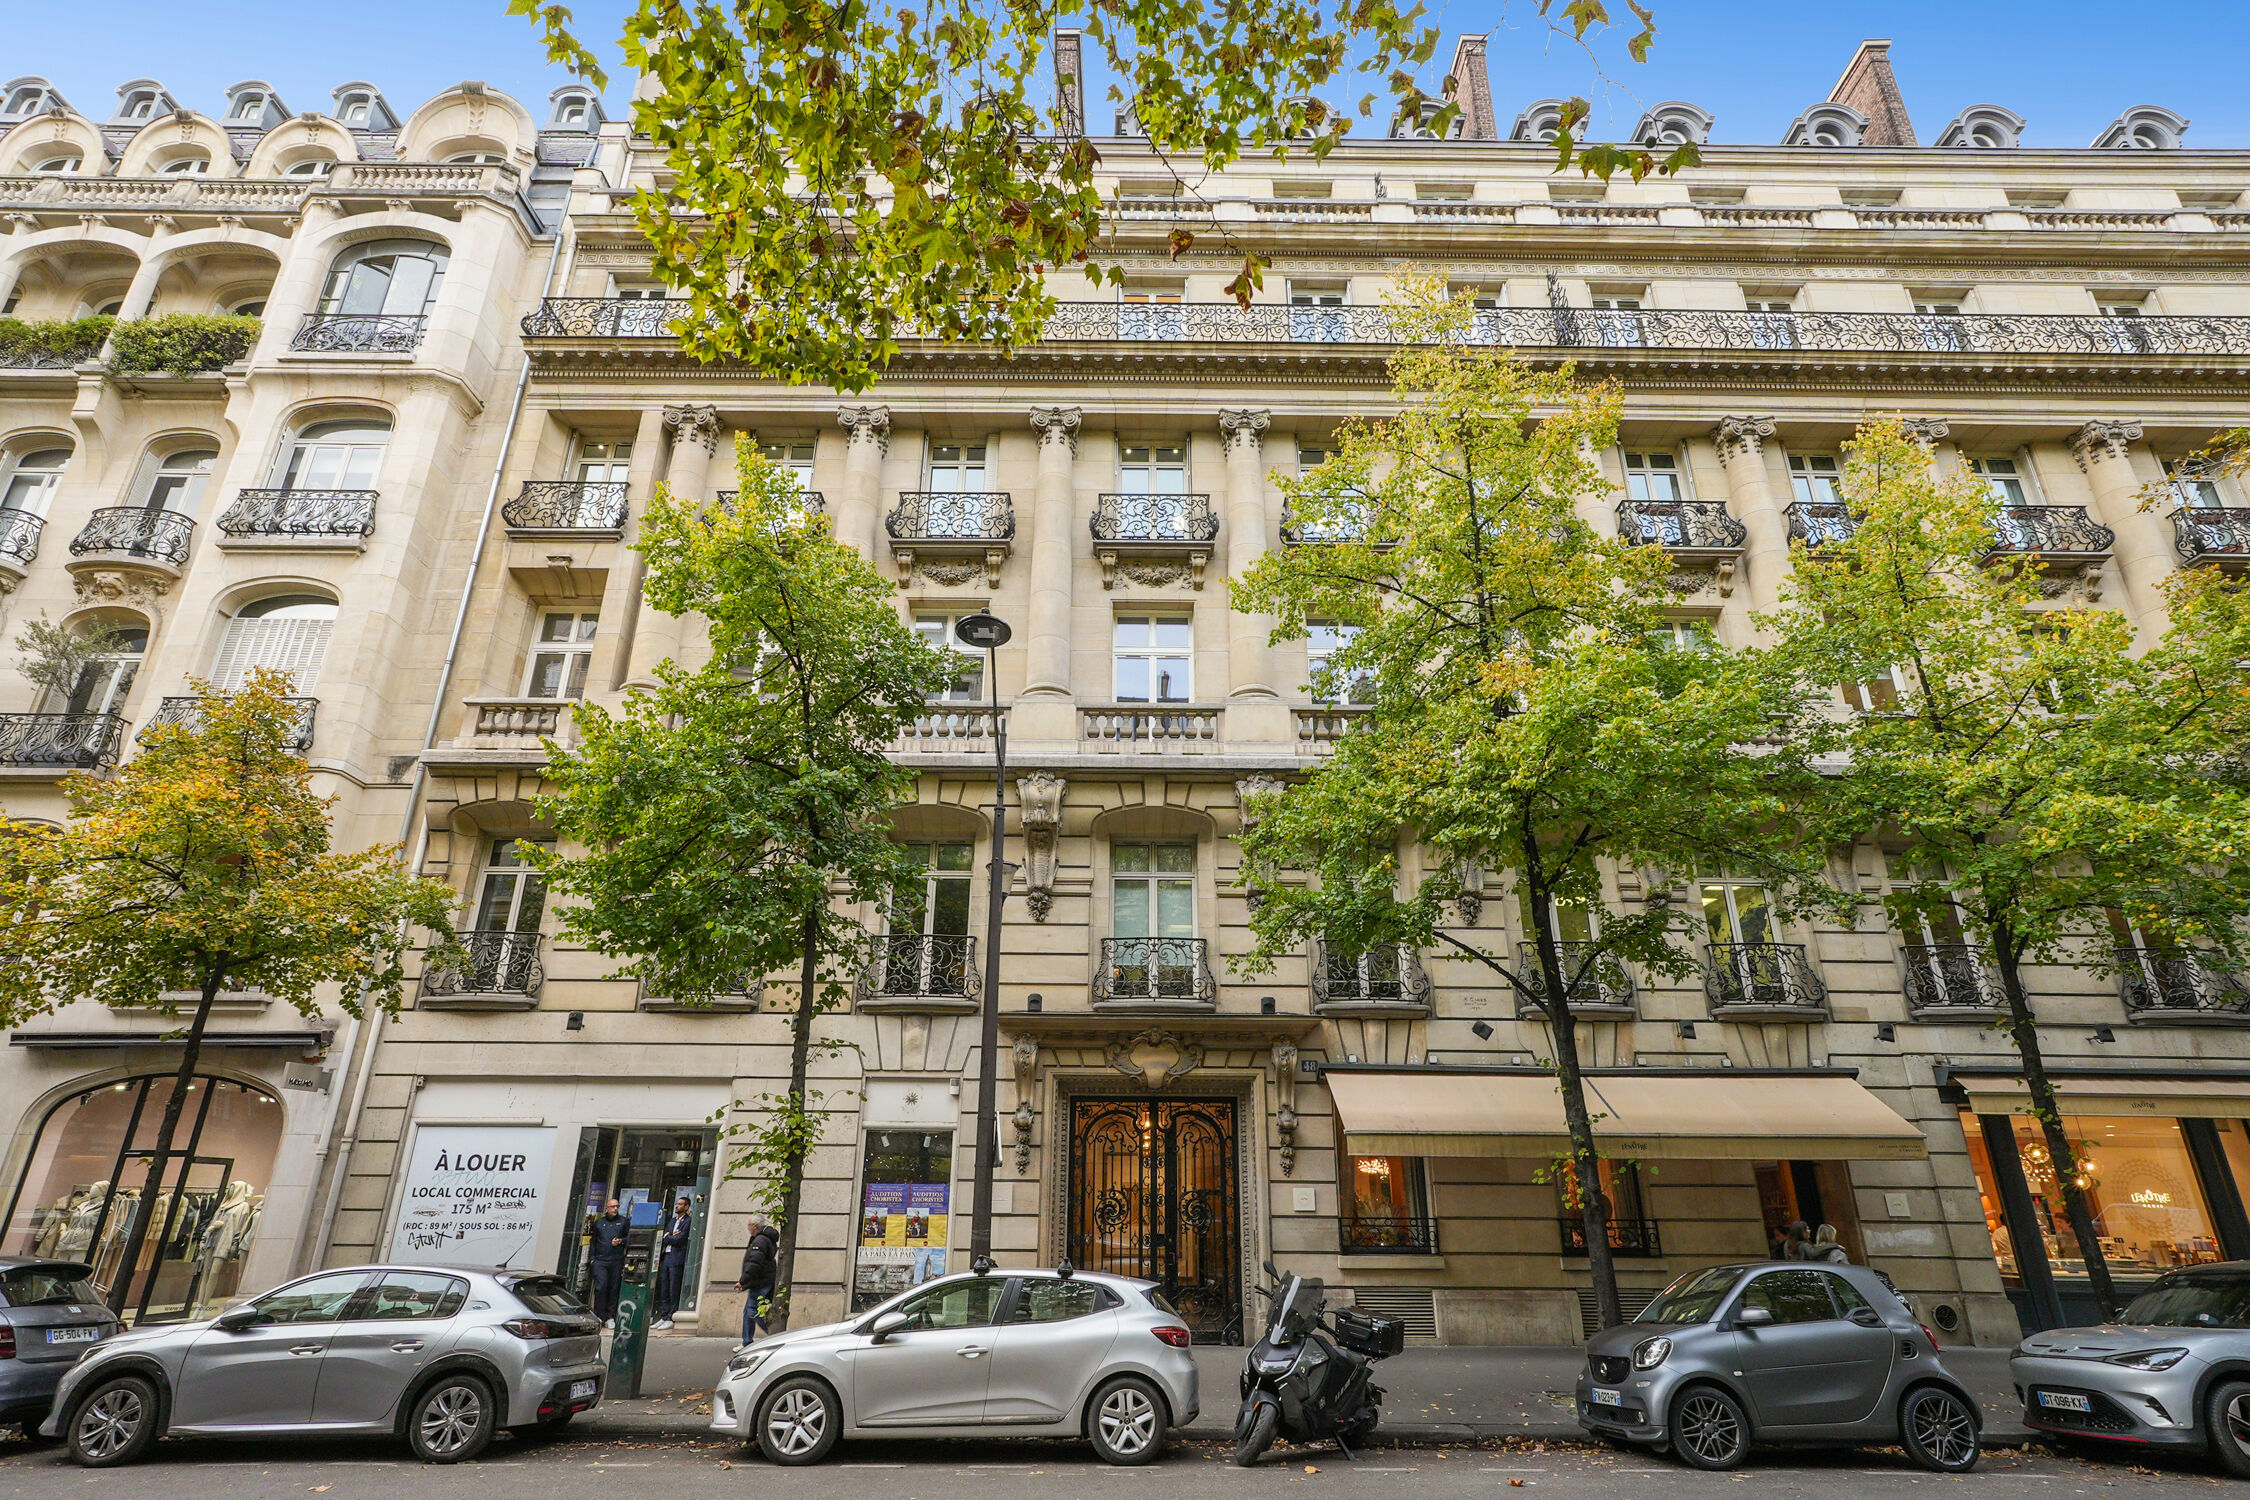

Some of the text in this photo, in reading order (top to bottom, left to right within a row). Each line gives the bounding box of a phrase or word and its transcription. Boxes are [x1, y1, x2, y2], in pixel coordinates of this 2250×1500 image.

[1304, 1061, 1316, 1071] 48
[434, 1149, 527, 1172] À LOUER
[412, 1187, 538, 1199] LOCAL COMMERCIAL
[2131, 1189, 2171, 1204] LENÔTRE
[451, 1204, 472, 1215] 175
[403, 1222, 423, 1231] (RDC
[429, 1222, 439, 1230] 89
[459, 1222, 482, 1230] SOUS
[483, 1222, 500, 1230] SOL
[506, 1222, 517, 1231] 86
[2044, 1394, 2084, 1409] GT-096-KX
